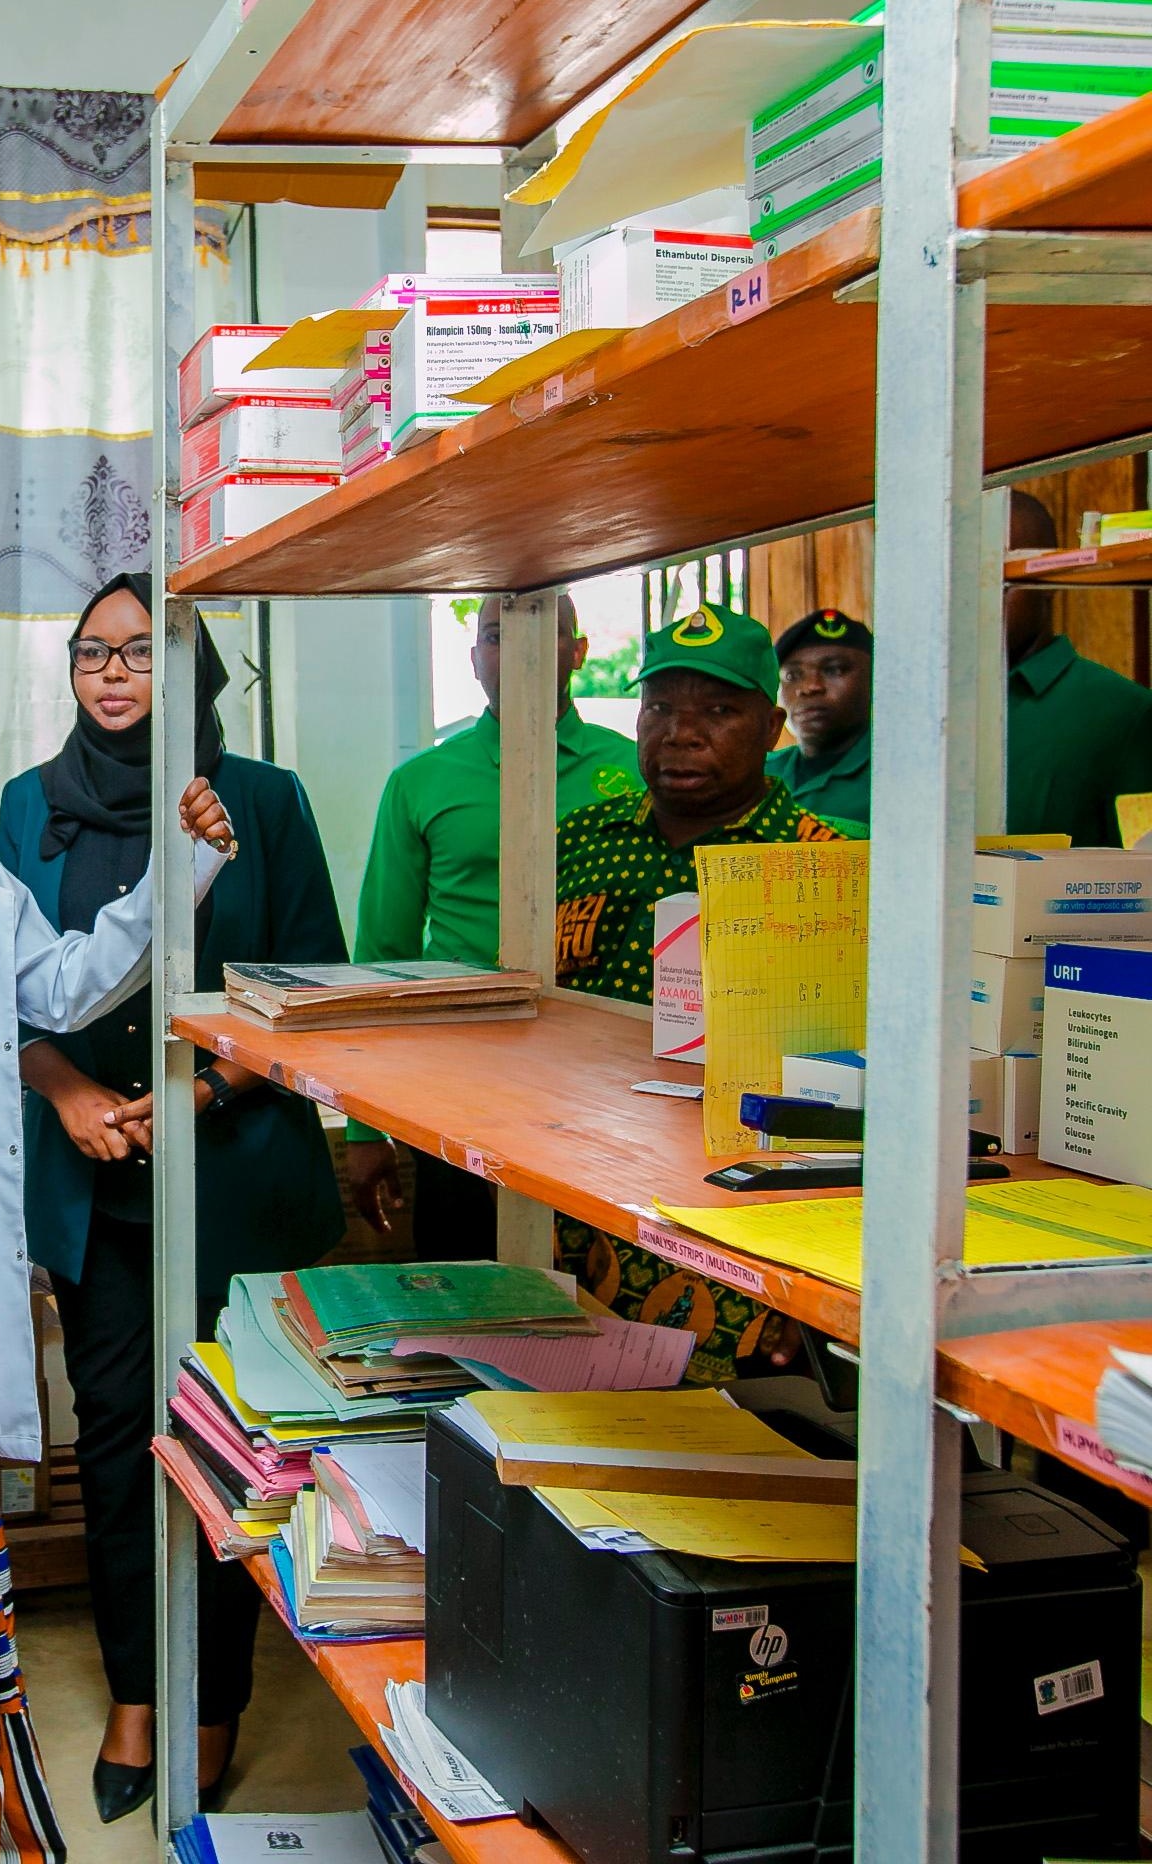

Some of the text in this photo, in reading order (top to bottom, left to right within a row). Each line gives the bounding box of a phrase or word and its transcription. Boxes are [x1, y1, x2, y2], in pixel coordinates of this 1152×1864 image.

[655, 248, 754, 265] Ethambutol Dispersib
[477, 304, 490, 313] 24
[498, 303, 511, 313] 28
[426, 325, 464, 337] Rifampicin
[467, 324, 492, 337] 150mg
[533, 323, 554, 336] 75mg
[545, 386, 558, 400] RHZ
[250, 398, 261, 406] 24
[1065, 882, 1143, 894] RAPID TEST STRIP
[1071, 901, 1086, 910] vitro
[1086, 900, 1121, 912] diagnostic
[1122, 902, 1134, 910] use
[1053, 964, 1083, 982] URIT
[659, 986, 703, 1001] AXAMOL
[1068, 1008, 1112, 1023] Leukocytes
[1067, 1023, 1119, 1039] Urobilinogen
[1067, 1038, 1101, 1052] Bilirubin
[1066, 1052, 1089, 1065] Blood
[1066, 1067, 1092, 1081] Nitrite
[1065, 1083, 1077, 1093] pH
[1065, 1097, 1128, 1120] Specific Gravity
[1065, 1112, 1094, 1126] Protein
[1064, 1127, 1096, 1142] Glucose
[1064, 1141, 1093, 1156] Ketone
[471, 1156, 481, 1168] UPT
[638, 1228, 760, 1287] URINALYSIS STRIPS (MULTISTRIX)
[755, 1625, 783, 1667] hp
[744, 1671, 769, 1682] Simply
[759, 1671, 798, 1686] Computers
